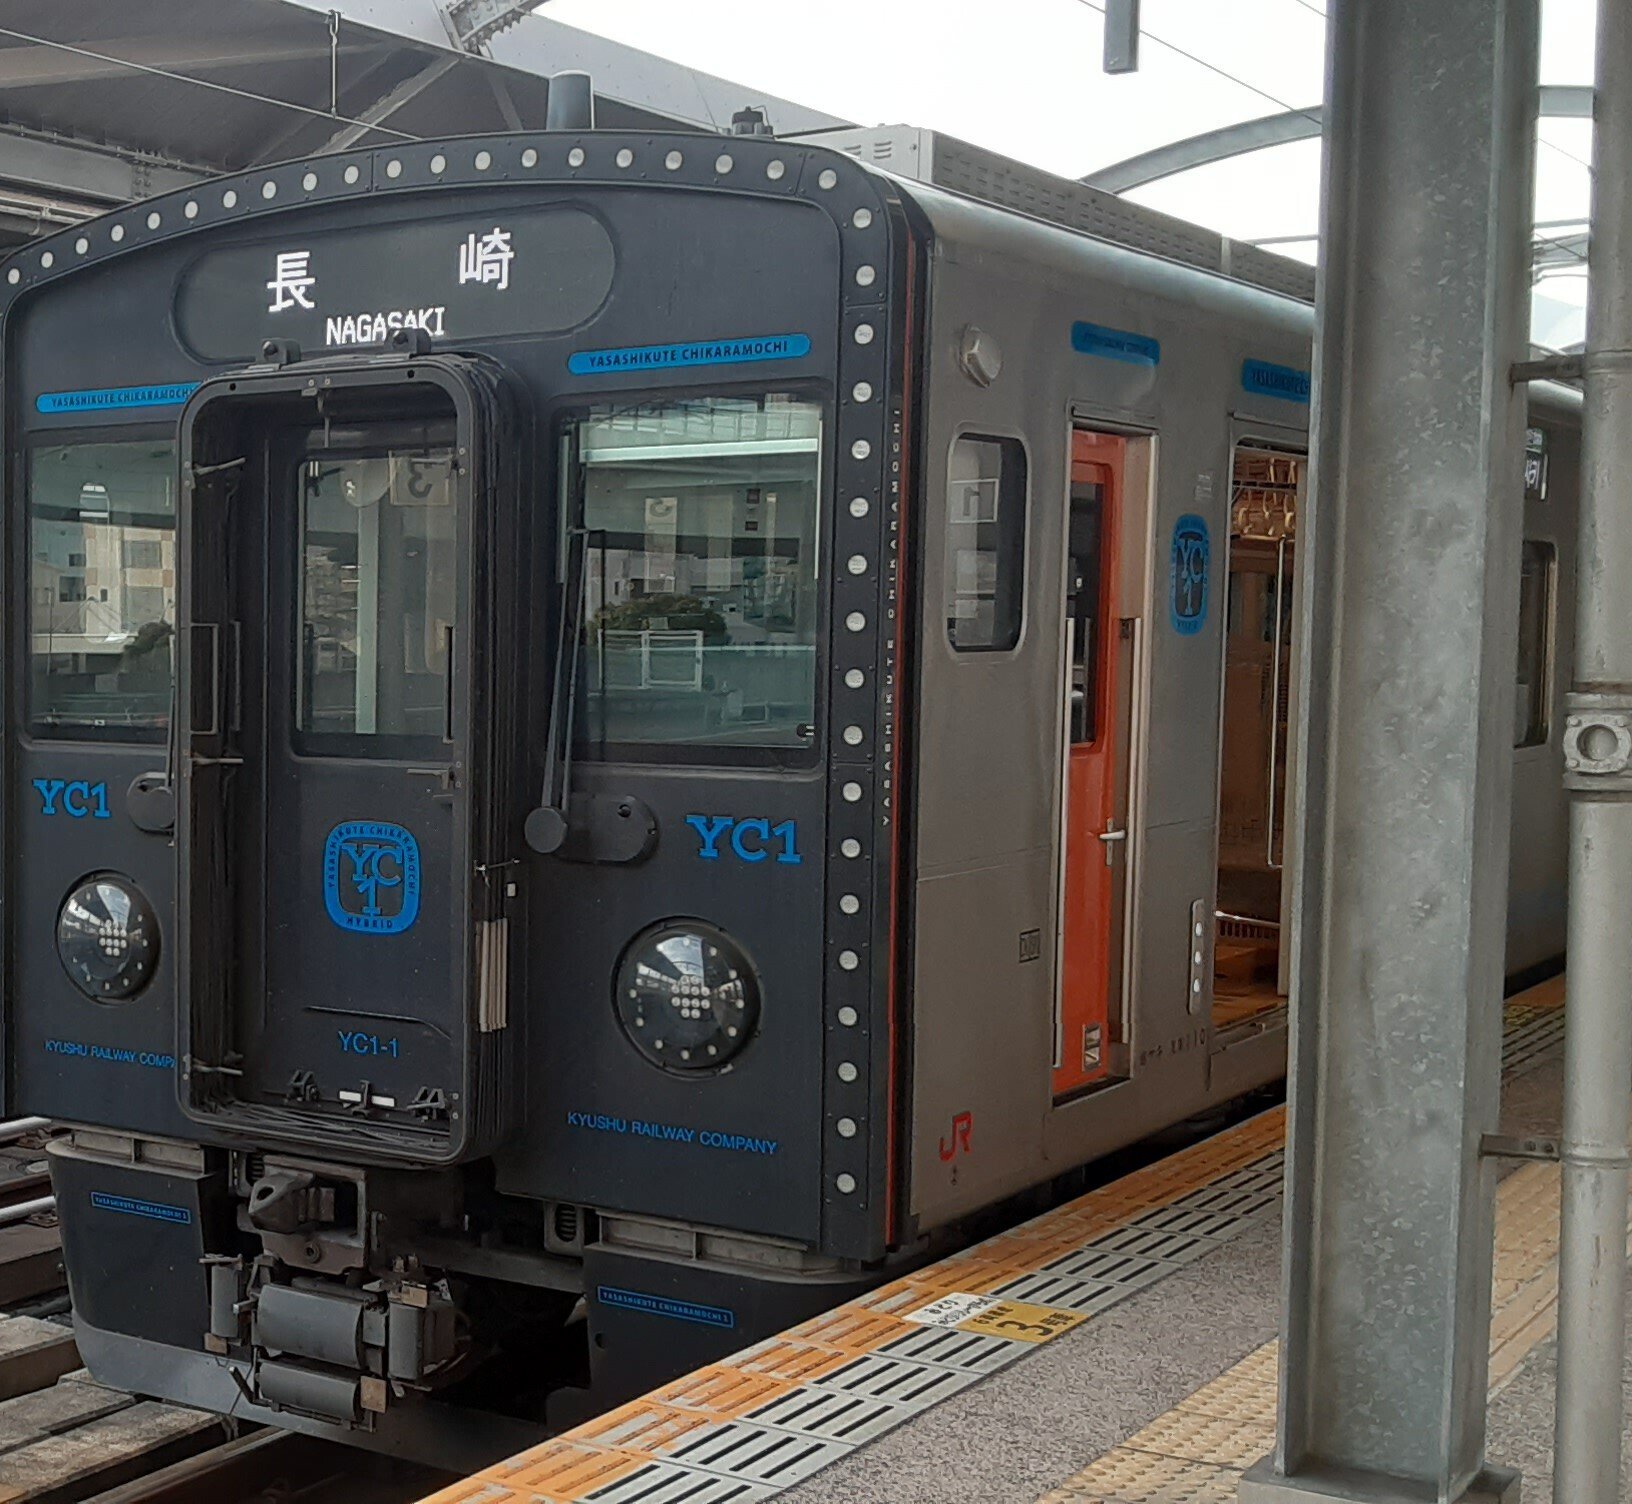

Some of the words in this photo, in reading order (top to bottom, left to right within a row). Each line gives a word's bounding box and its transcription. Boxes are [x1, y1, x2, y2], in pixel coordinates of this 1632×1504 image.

[326, 306, 445, 345] NAGASAKI
[589, 351, 676, 366] YASASHIKUTE
[683, 340, 789, 359] CHIKARAMOCHI
[52, 395, 114, 407] YASASHIKUTE
[32, 779, 111, 818] YC1
[685, 814, 802, 863] YC1
[341, 843, 404, 887] YC
[357, 876, 382, 916] 1
[347, 917, 393, 929] HYBRID
[45, 1040, 87, 1056] KYUSHU
[91, 1046, 137, 1062] RAILWAY
[337, 1030, 399, 1058] YC1-1
[567, 1112, 627, 1133] KYUSHU
[631, 1121, 695, 1143] RAILWAY
[699, 1131, 777, 1155] COMPANY
[939, 1110, 973, 1162] JR
